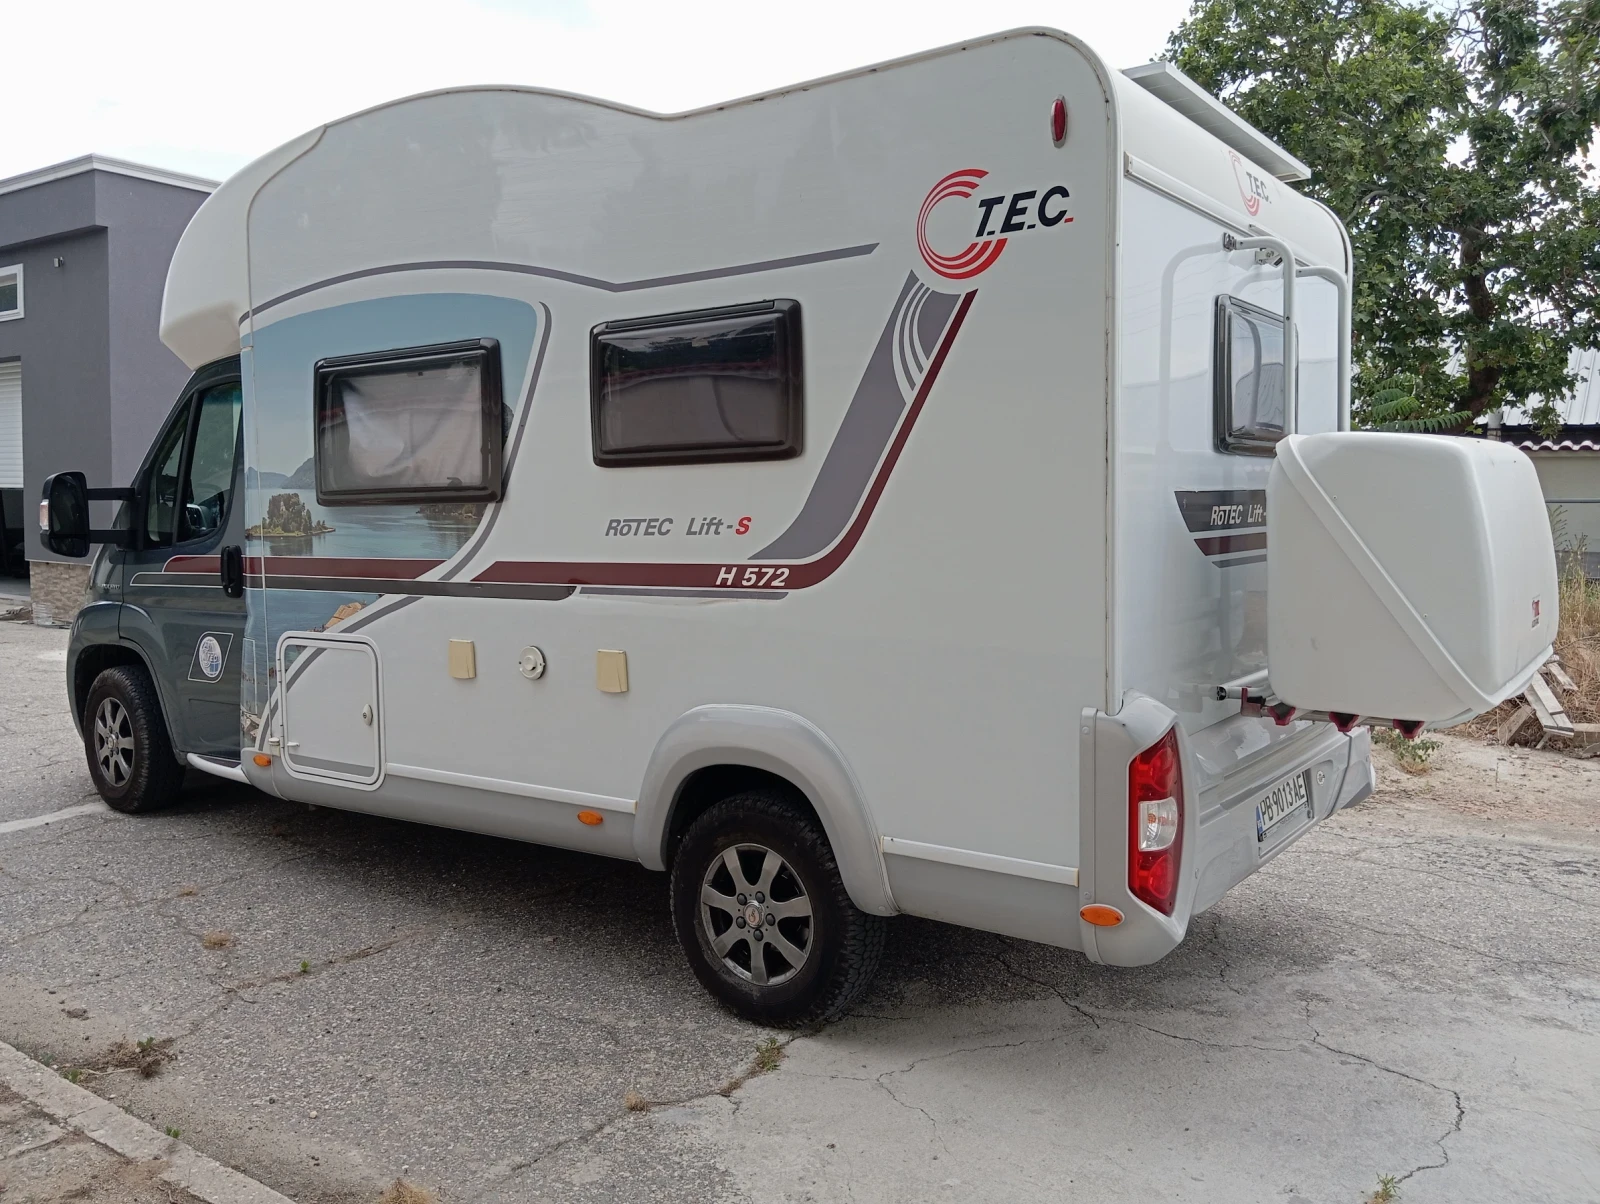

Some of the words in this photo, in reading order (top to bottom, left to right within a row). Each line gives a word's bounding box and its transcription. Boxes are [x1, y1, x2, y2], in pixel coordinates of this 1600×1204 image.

[975, 185, 1074, 238] T.E.C.
[715, 566, 738, 587] H
[741, 567, 790, 587] 572
